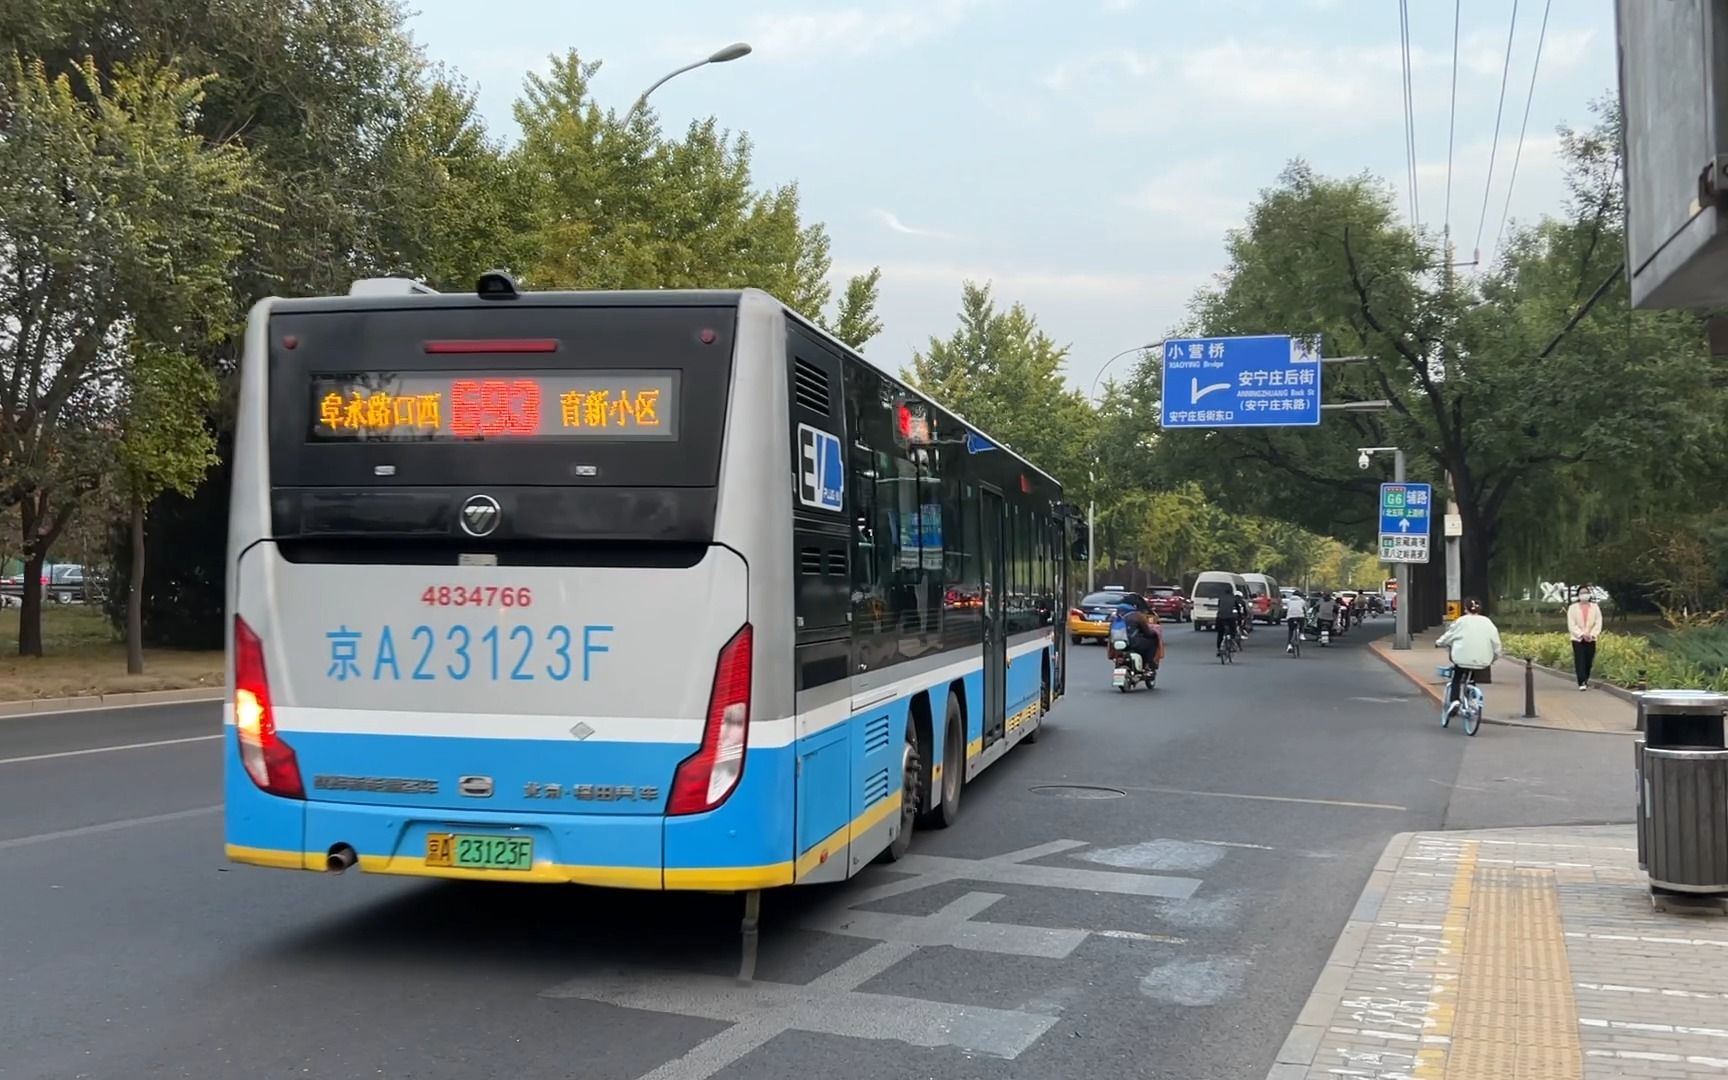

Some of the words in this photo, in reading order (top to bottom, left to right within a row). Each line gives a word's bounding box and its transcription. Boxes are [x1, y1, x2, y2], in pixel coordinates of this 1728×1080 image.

[1168, 343, 1225, 359] 小营桥
[1238, 370, 1315, 386] 安宁庄后街
[320, 391, 441, 430] 阜永路口西
[560, 389, 659, 428] 育新小区
[1239, 399, 1311, 412] (安宁庄东路)
[1169, 410, 1233, 422] 安宁庄后街东口
[1387, 493, 1403, 505] G6
[1407, 490, 1428, 505] 辅路
[421, 586, 532, 607] 4834766
[326, 624, 614, 681] 京A23123F
